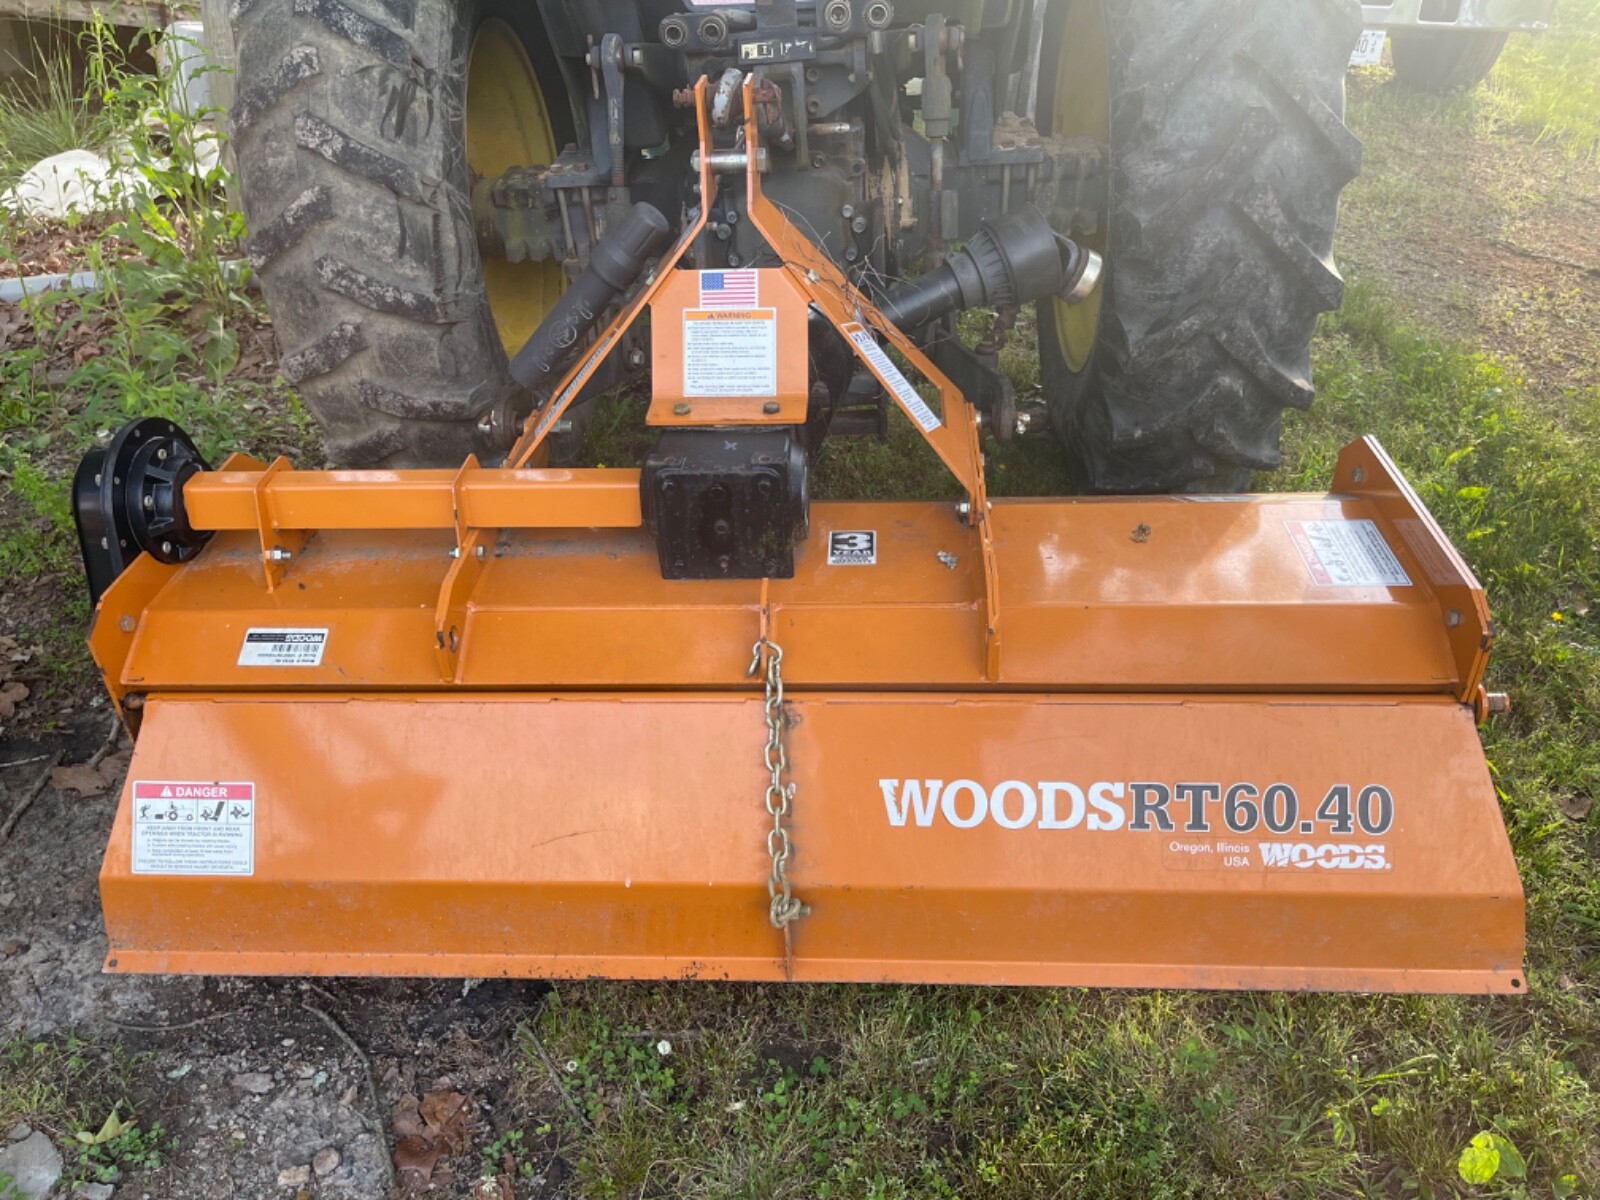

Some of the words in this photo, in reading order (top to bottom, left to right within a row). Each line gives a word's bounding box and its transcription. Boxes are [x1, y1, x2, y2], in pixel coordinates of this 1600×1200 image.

[175, 786, 228, 798] DANGER
[1169, 841, 1214, 855] Oregon,
[1216, 842, 1250, 854] Illinois
[1223, 856, 1250, 868] USA
